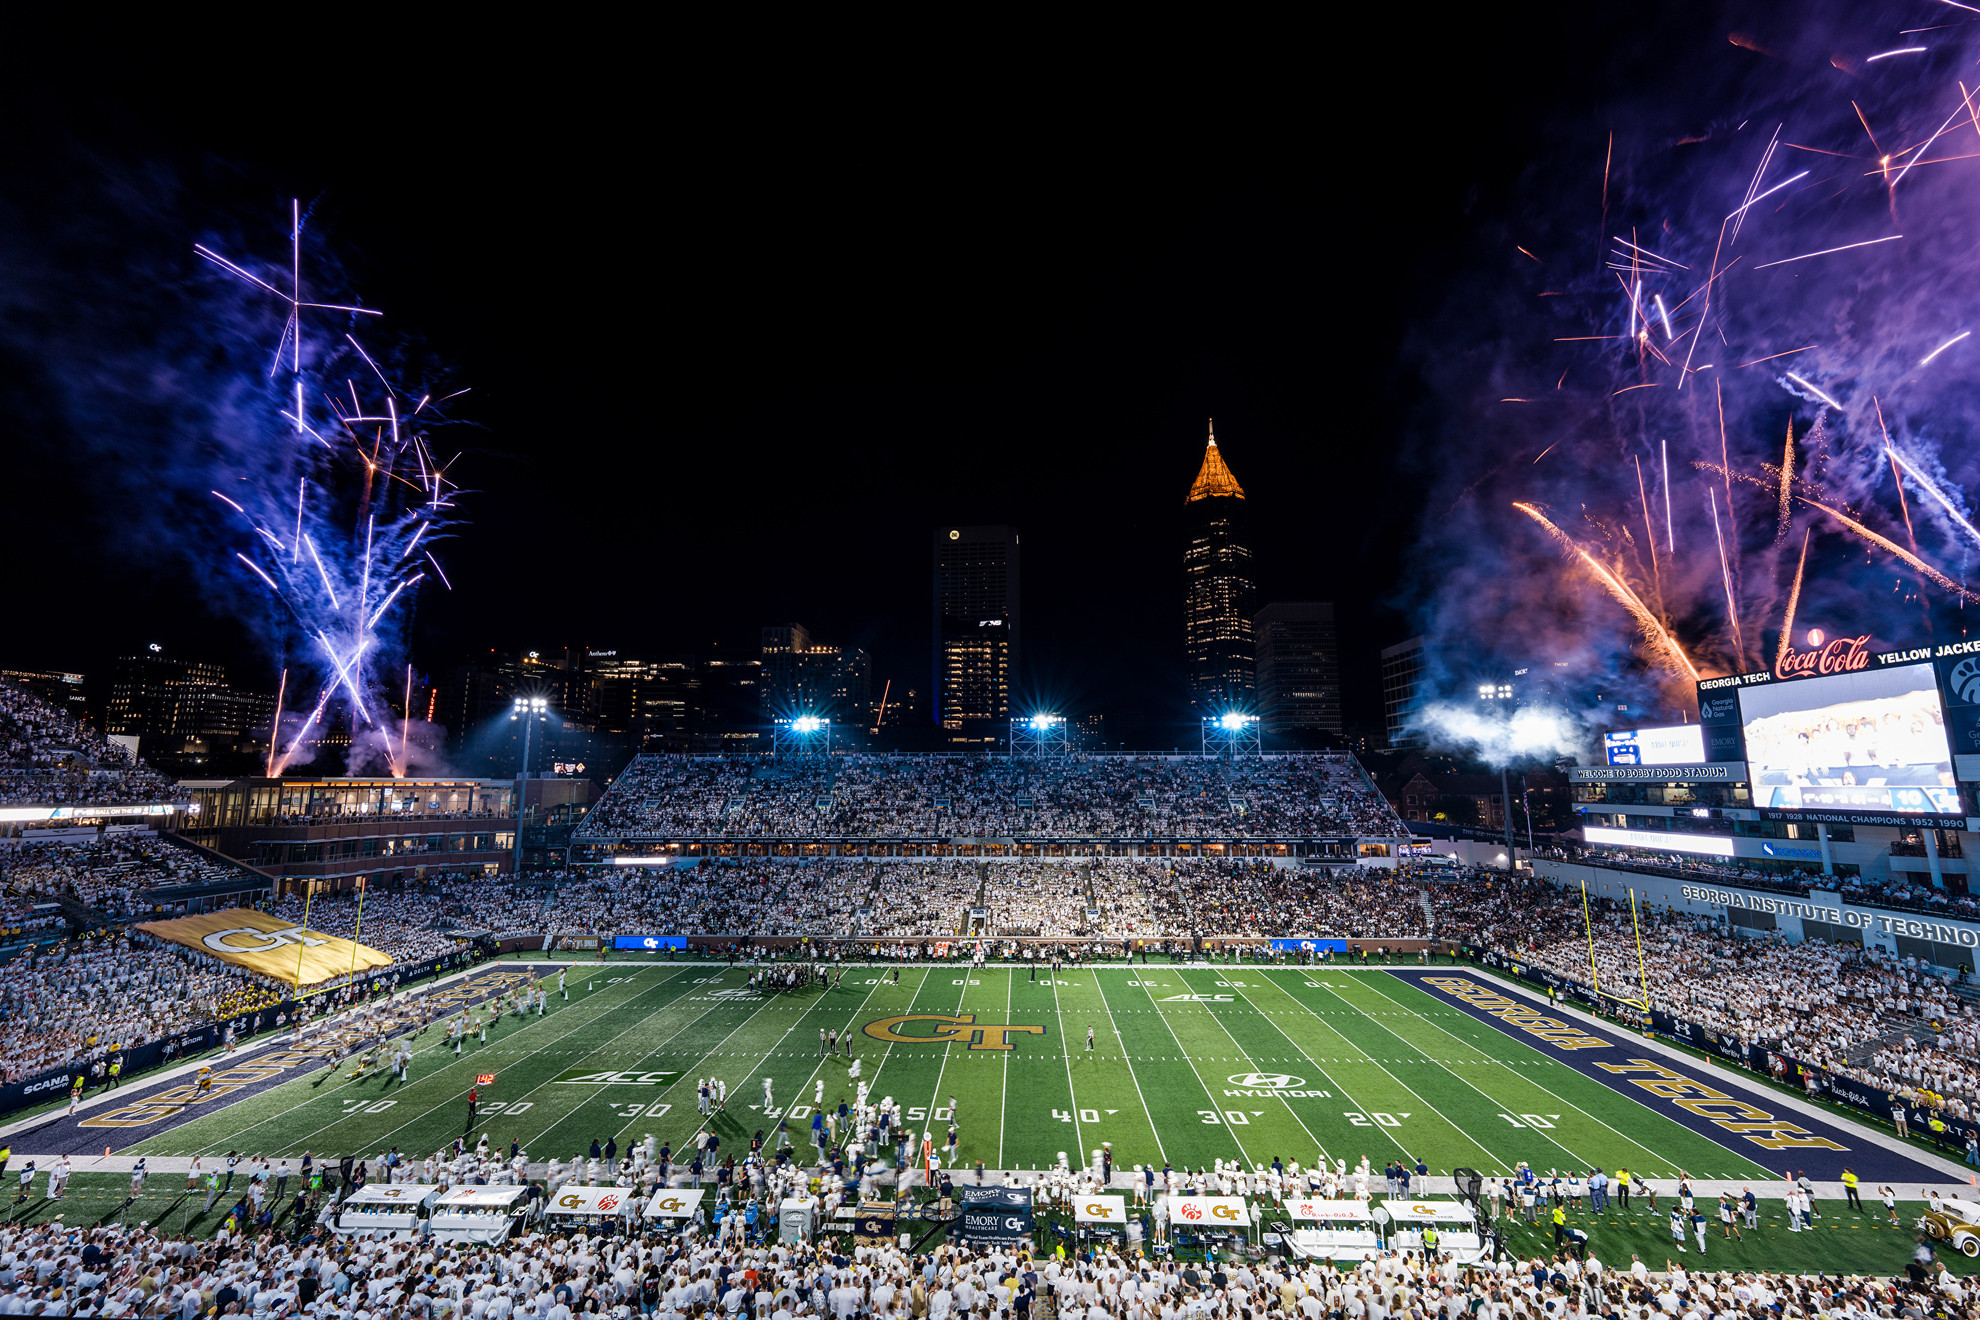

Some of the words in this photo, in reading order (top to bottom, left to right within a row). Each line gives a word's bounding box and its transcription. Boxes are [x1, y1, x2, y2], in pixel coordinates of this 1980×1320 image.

[1775, 634, 1872, 680] Coca-Cola
[1877, 647, 1931, 665] YELLOW
[1700, 677, 1742, 690] GEORGIA
[1743, 671, 1771, 684] TECH
[1712, 698, 1734, 707] Georgia
[1711, 737, 1736, 746] EMORY
[1577, 769, 1614, 778] WELCOME
[1615, 769, 1626, 778] TO
[1626, 768, 1654, 778] BOBBY
[1656, 767, 1682, 778] DODD
[1684, 766, 1728, 778] STADIUM
[188, 804, 200, 814] 25
[1806, 814, 1850, 823] NATIONAL
[1851, 815, 1906, 826] CHAMPIONS
[1911, 818, 1934, 827] 1952
[1939, 819, 1964, 828] 1990
[1680, 884, 1744, 908] GEORGIA
[1748, 894, 1840, 924] INSTITUTE
[1844, 910, 1872, 929] OF
[202, 926, 332, 954] GT
[644, 938, 658, 948] GT
[1486, 952, 1498, 966] GT
[1576, 986, 1598, 998] SCANA
[1420, 976, 1616, 1051] GEORGIA
[862, 1014, 1047, 1051] GT
[476, 1074, 494, 1084] 1:42
[565, 1070, 678, 1084] ACC
[24, 1074, 70, 1095] SCANA
[50, 1080, 70, 1090] energy
[1222, 1090, 1332, 1098] HYUNDAI
[342, 1100, 398, 1113] 10
[475, 1102, 534, 1115] 20
[617, 1104, 673, 1118] 30
[1592, 1058, 1852, 1152] TECH
[762, 1105, 812, 1120] 40
[906, 1107, 952, 1121] 50
[1052, 1108, 1101, 1124] 40
[1197, 1110, 1250, 1124] 30
[1342, 1112, 1402, 1126] 20
[1497, 1113, 1557, 1128] 10
[964, 1188, 1000, 1197] EMORY
[1006, 1192, 1028, 1202] GT
[558, 1194, 586, 1209] GT
[659, 1198, 686, 1212] GT
[1086, 1204, 1112, 1218] GT
[1212, 1204, 1240, 1222] GT
[1412, 1205, 1436, 1216] GT
[964, 1214, 1000, 1225] EMORY
[1004, 1217, 1025, 1232] GT
[864, 1220, 882, 1234] GT
